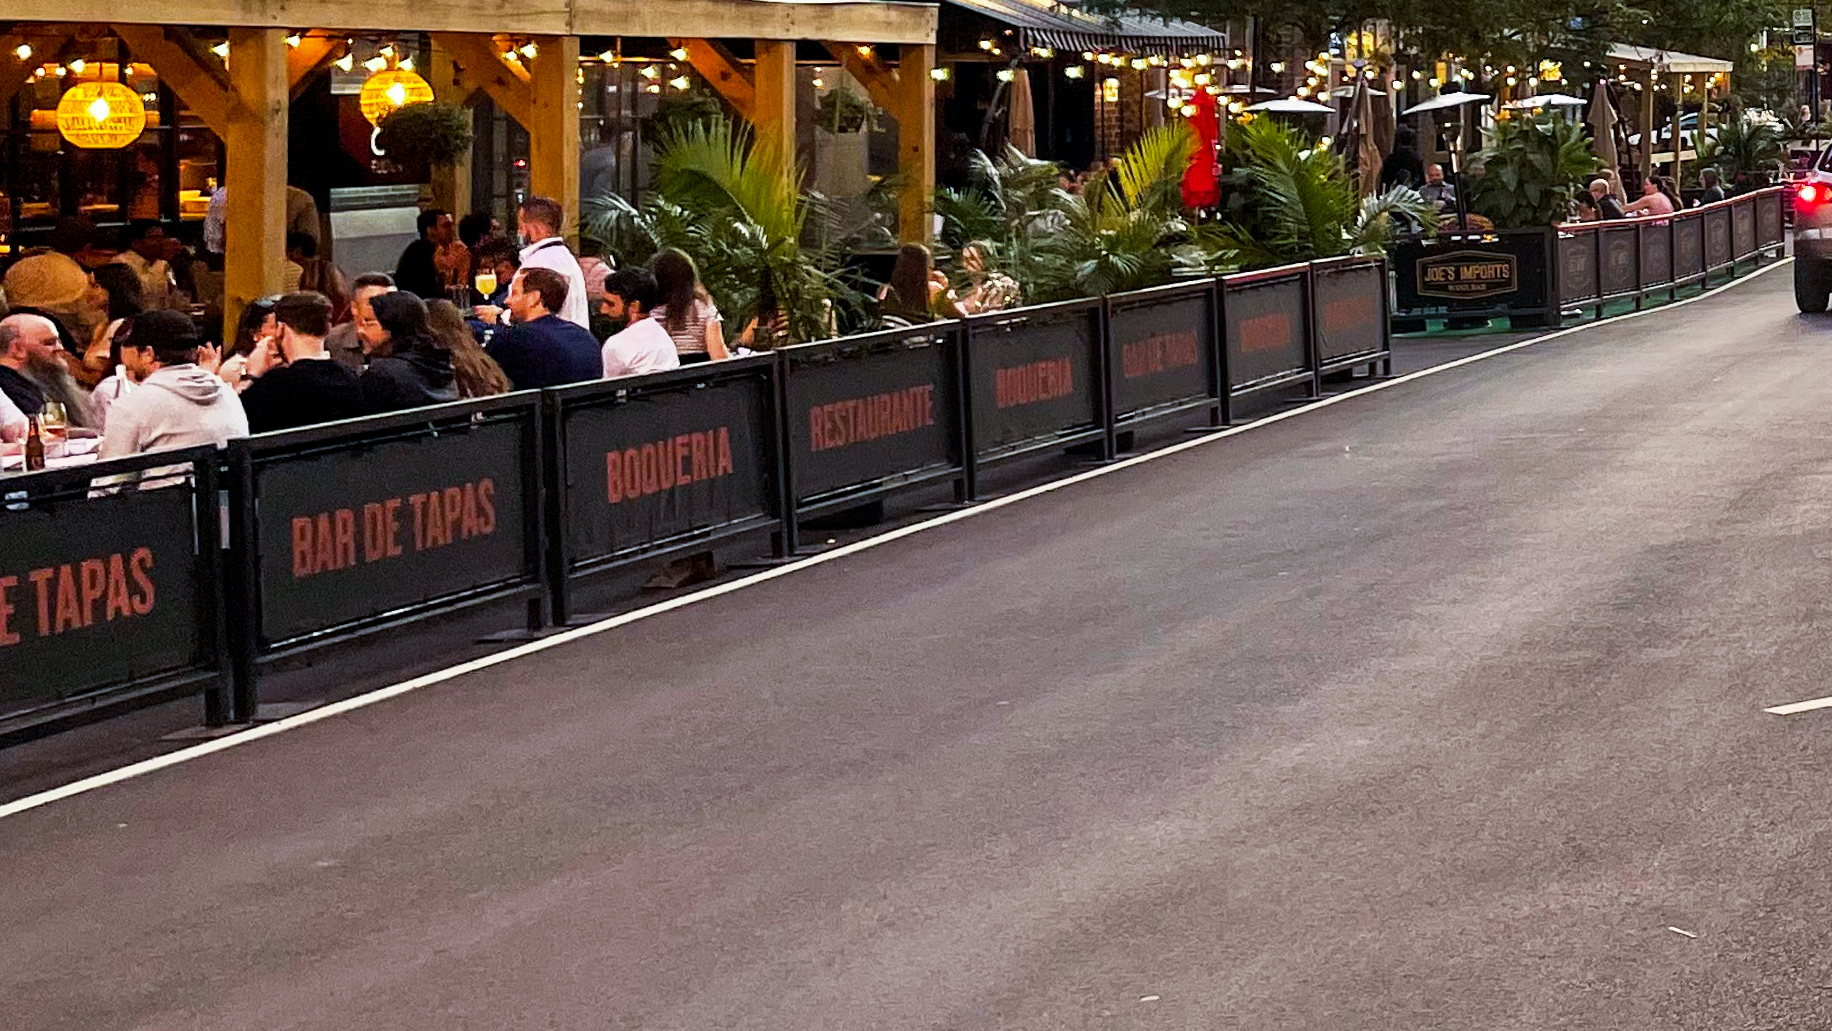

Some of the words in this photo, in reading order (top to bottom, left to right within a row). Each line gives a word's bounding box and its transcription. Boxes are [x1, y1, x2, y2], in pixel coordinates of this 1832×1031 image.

[1424, 266, 1456, 282] JOE'S
[1459, 264, 1510, 280] IMPORTS
[810, 383, 934, 451] RESTAURANTE
[607, 427, 732, 504] BOQUERIA
[291, 502, 356, 578] BAR
[363, 502, 400, 564] DE
[408, 476, 496, 551] TAPAS
[28, 547, 155, 637] TAPAS
